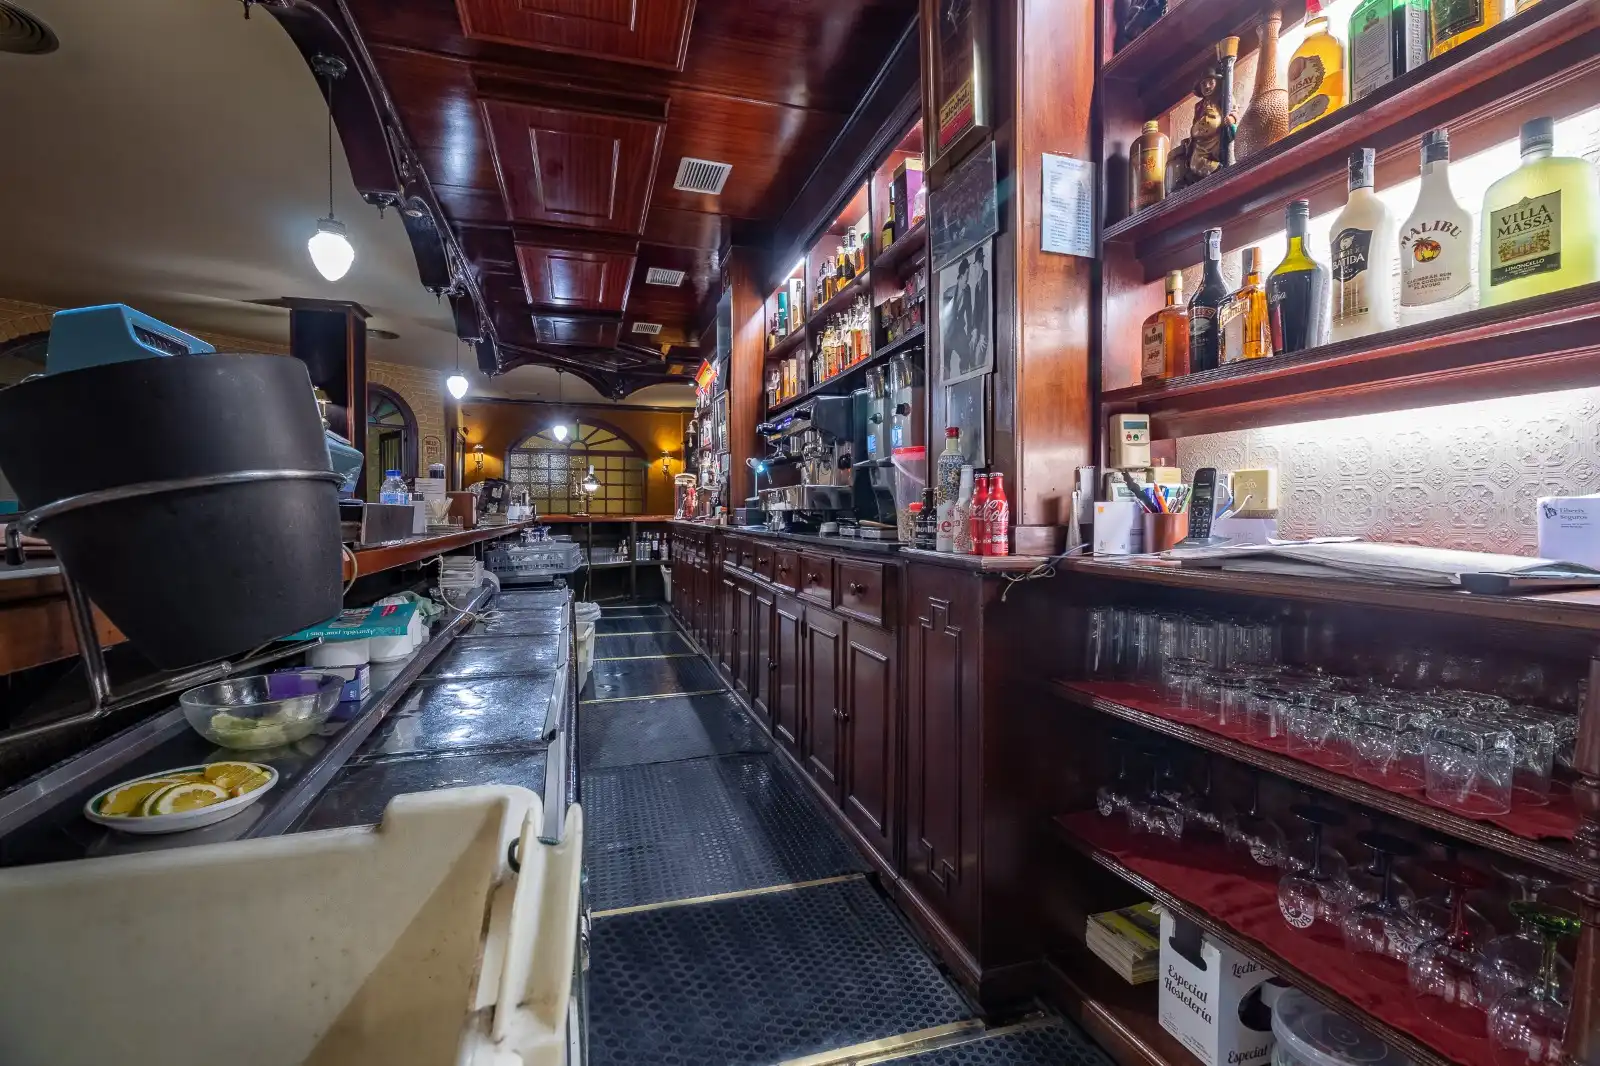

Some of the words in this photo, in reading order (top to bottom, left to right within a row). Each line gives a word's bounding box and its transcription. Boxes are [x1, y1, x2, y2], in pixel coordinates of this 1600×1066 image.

[1497, 213, 1554, 239] MASSA
[1501, 204, 1549, 226] VILLA
[1401, 220, 1462, 249] MALIBU
[1333, 253, 1366, 271] BATIDA
[1505, 258, 1545, 273] LIMONCELLO
[1231, 961, 1258, 979] Leche
[1168, 964, 1209, 1004] Especial
[1165, 977, 1213, 1025] Hostelería
[1228, 1045, 1268, 1065] Especial
